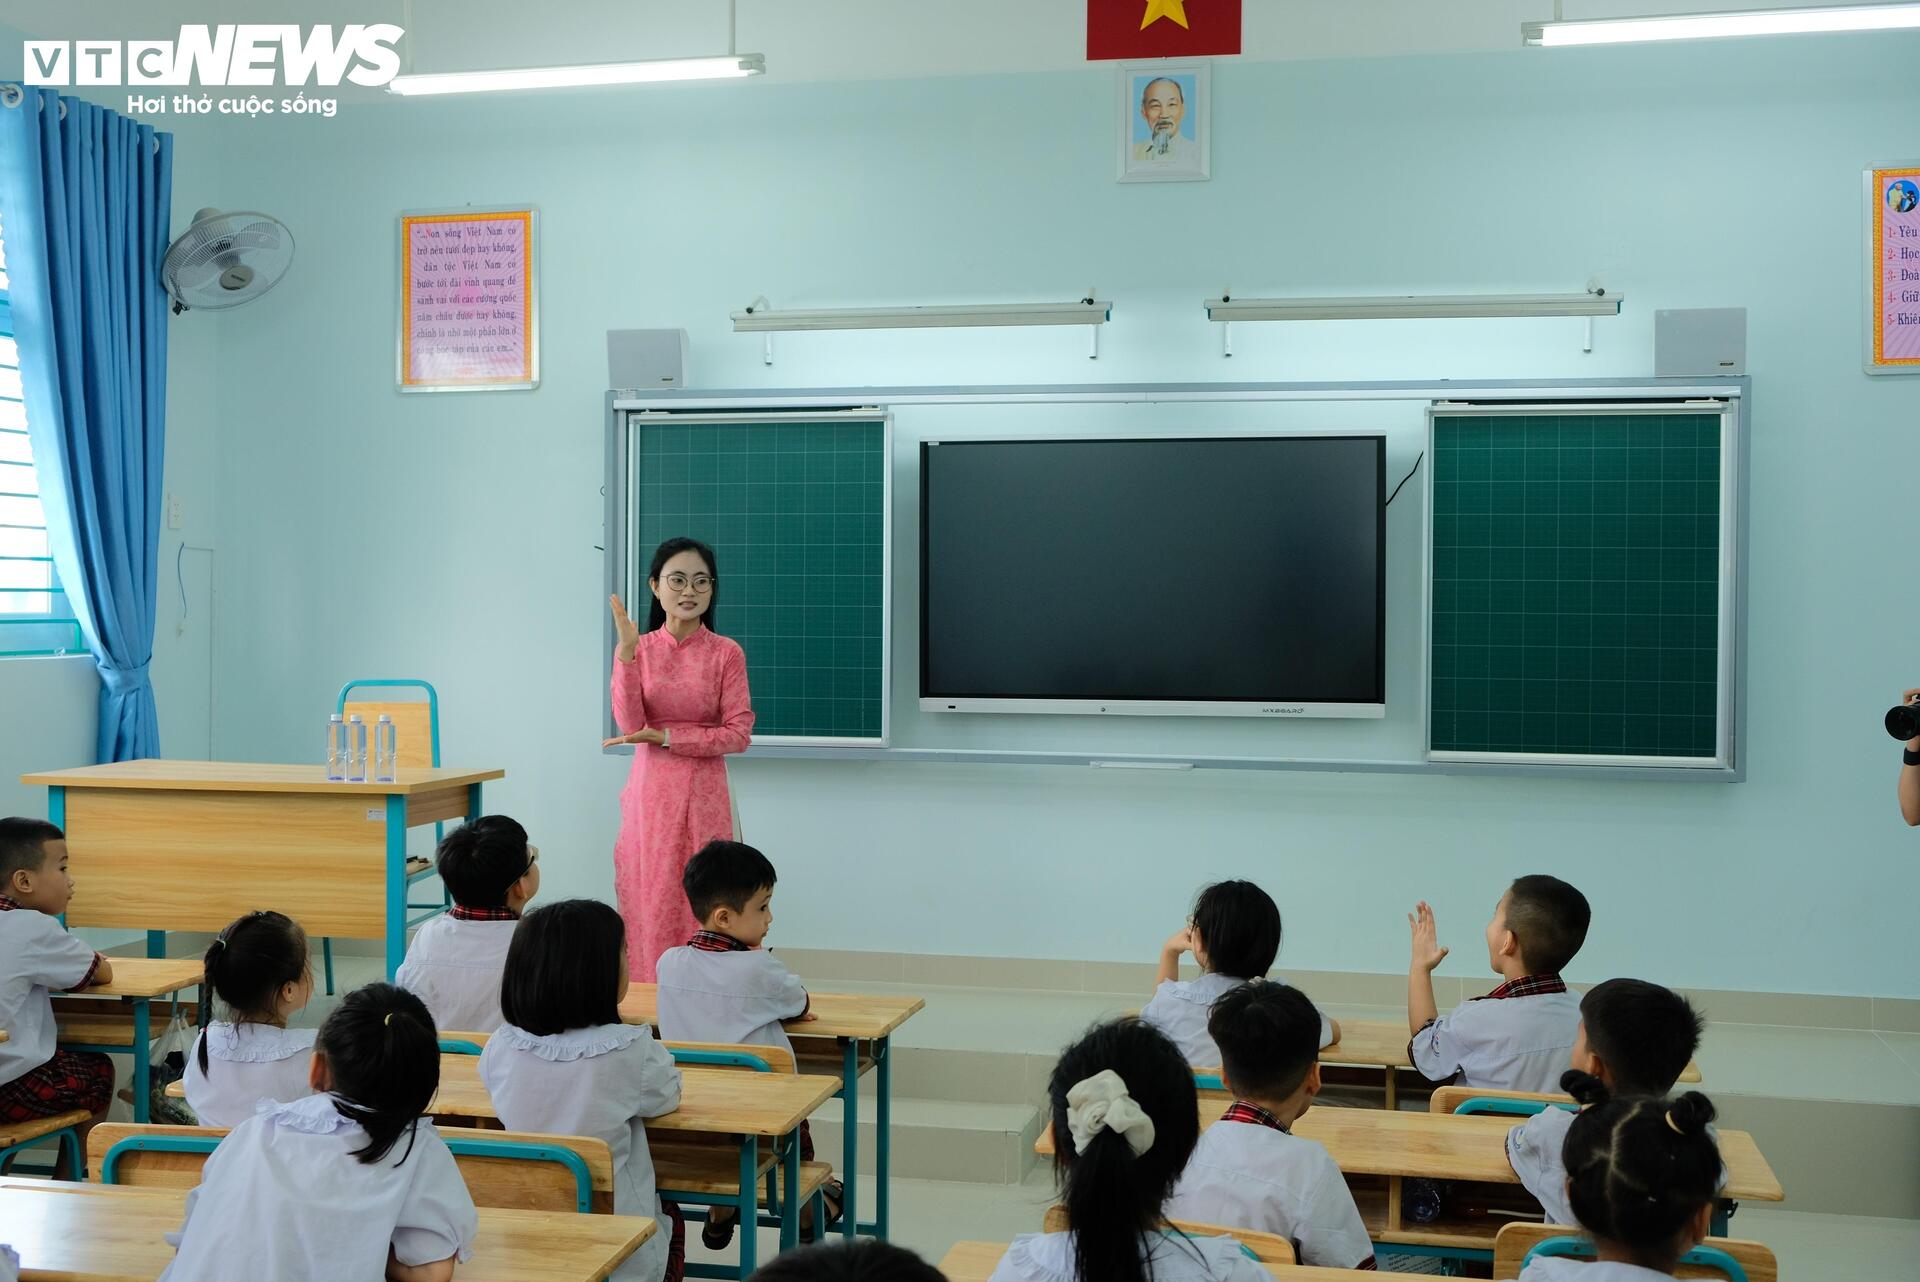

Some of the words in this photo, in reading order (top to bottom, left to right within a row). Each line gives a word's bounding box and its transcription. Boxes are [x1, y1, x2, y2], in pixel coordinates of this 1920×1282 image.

[466, 226, 482, 237] Việt
[486, 226, 503, 236] Nam
[1899, 225, 1918, 238] Yêu
[477, 243, 490, 255] hay
[1901, 247, 1920, 262] Học
[462, 260, 478, 270] Việt
[484, 259, 501, 270] Nam
[482, 277, 505, 289] quang
[476, 310, 490, 321] hay
